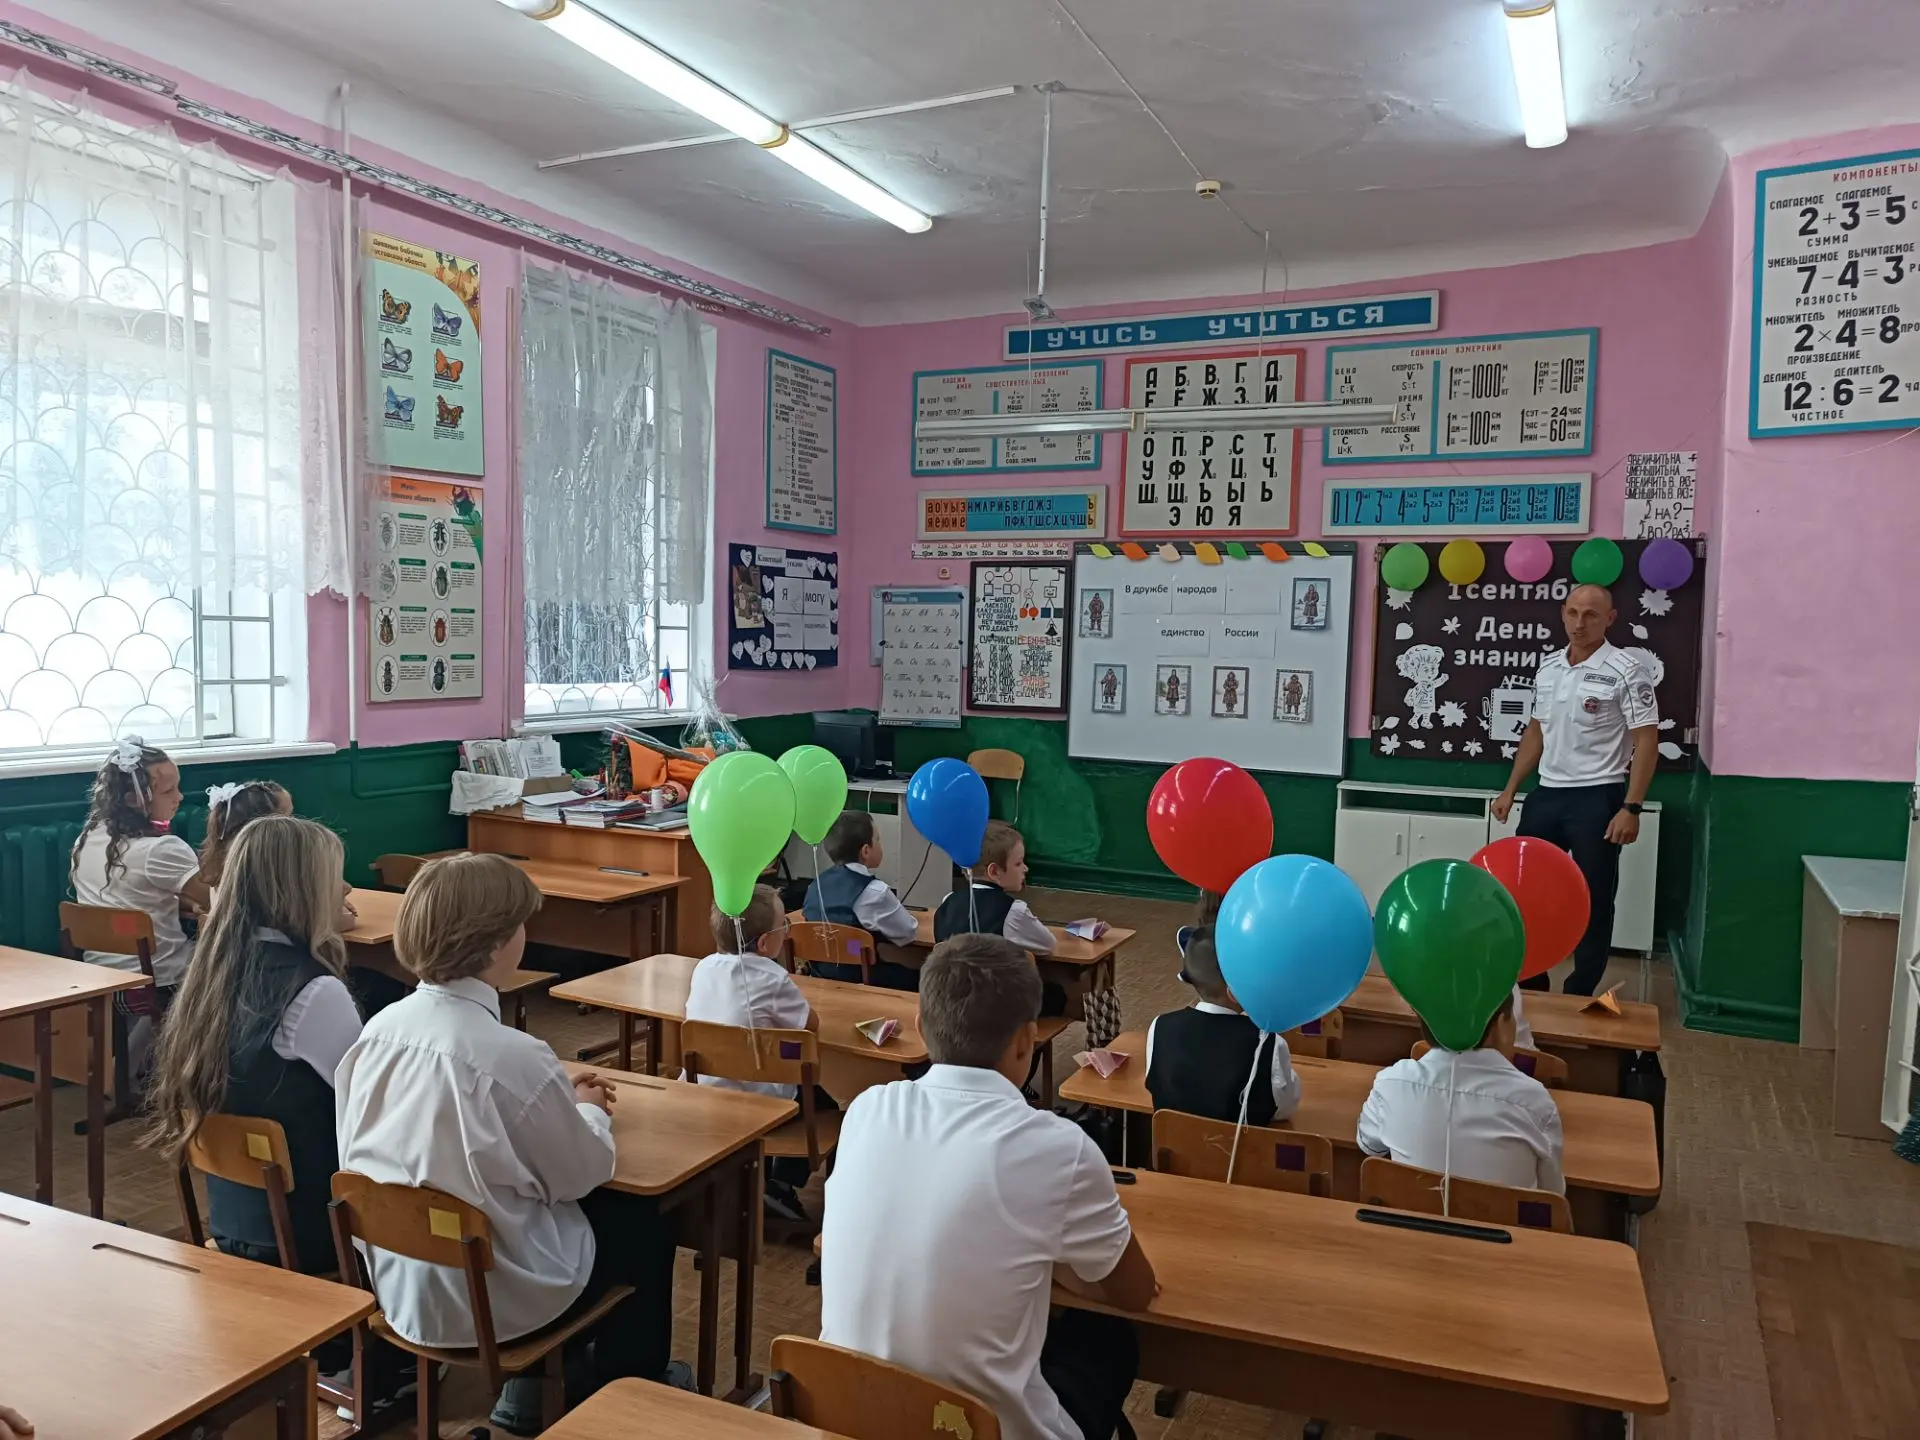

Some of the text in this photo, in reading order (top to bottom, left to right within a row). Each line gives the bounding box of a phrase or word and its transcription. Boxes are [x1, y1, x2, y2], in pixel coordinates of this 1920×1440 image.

[1833, 162, 1918, 182] КОМПОНЕНТЫ
[1770, 185, 1892, 210] СЛАГАЕМОЕ СЛАГАЕМОЕ
[1807, 234, 1849, 247] СУММА
[1768, 243, 1915, 268] УМЕНЬШАЕМОЕ ВЫЧИТАЕМОЕ
[1796, 293, 1858, 307] РАЗНОСТЬ
[1765, 304, 1901, 326] МНОЖИТЕЛЬ МНОЖИТЕЛЬ
[1047, 305, 1385, 348] УЧИСЬ УЧИТЬСЯ
[1787, 350, 1861, 366] ПРОИЗВЕДЕНИЕ
[1391, 362, 1424, 372] СКОРОСТЬ
[1763, 364, 1885, 384] ДЕЛИМОЕ ДЕЛИТЕЛЬ
[1471, 362, 1501, 399] 1000
[1398, 394, 1423, 403] ВРЕМЯ
[1550, 406, 1567, 418] 24
[1791, 409, 1845, 422] ЧАСТНОЕ
[1332, 428, 1369, 436] СТОИМОСТЬ
[1381, 426, 1421, 434] РАССТОЯНИЕ
[1550, 418, 1567, 442] 60
[1125, 585, 1218, 596] В дружбе народов
[805, 591, 825, 606] могу
[1161, 628, 1259, 638] единство России
[1476, 616, 1551, 642] День
